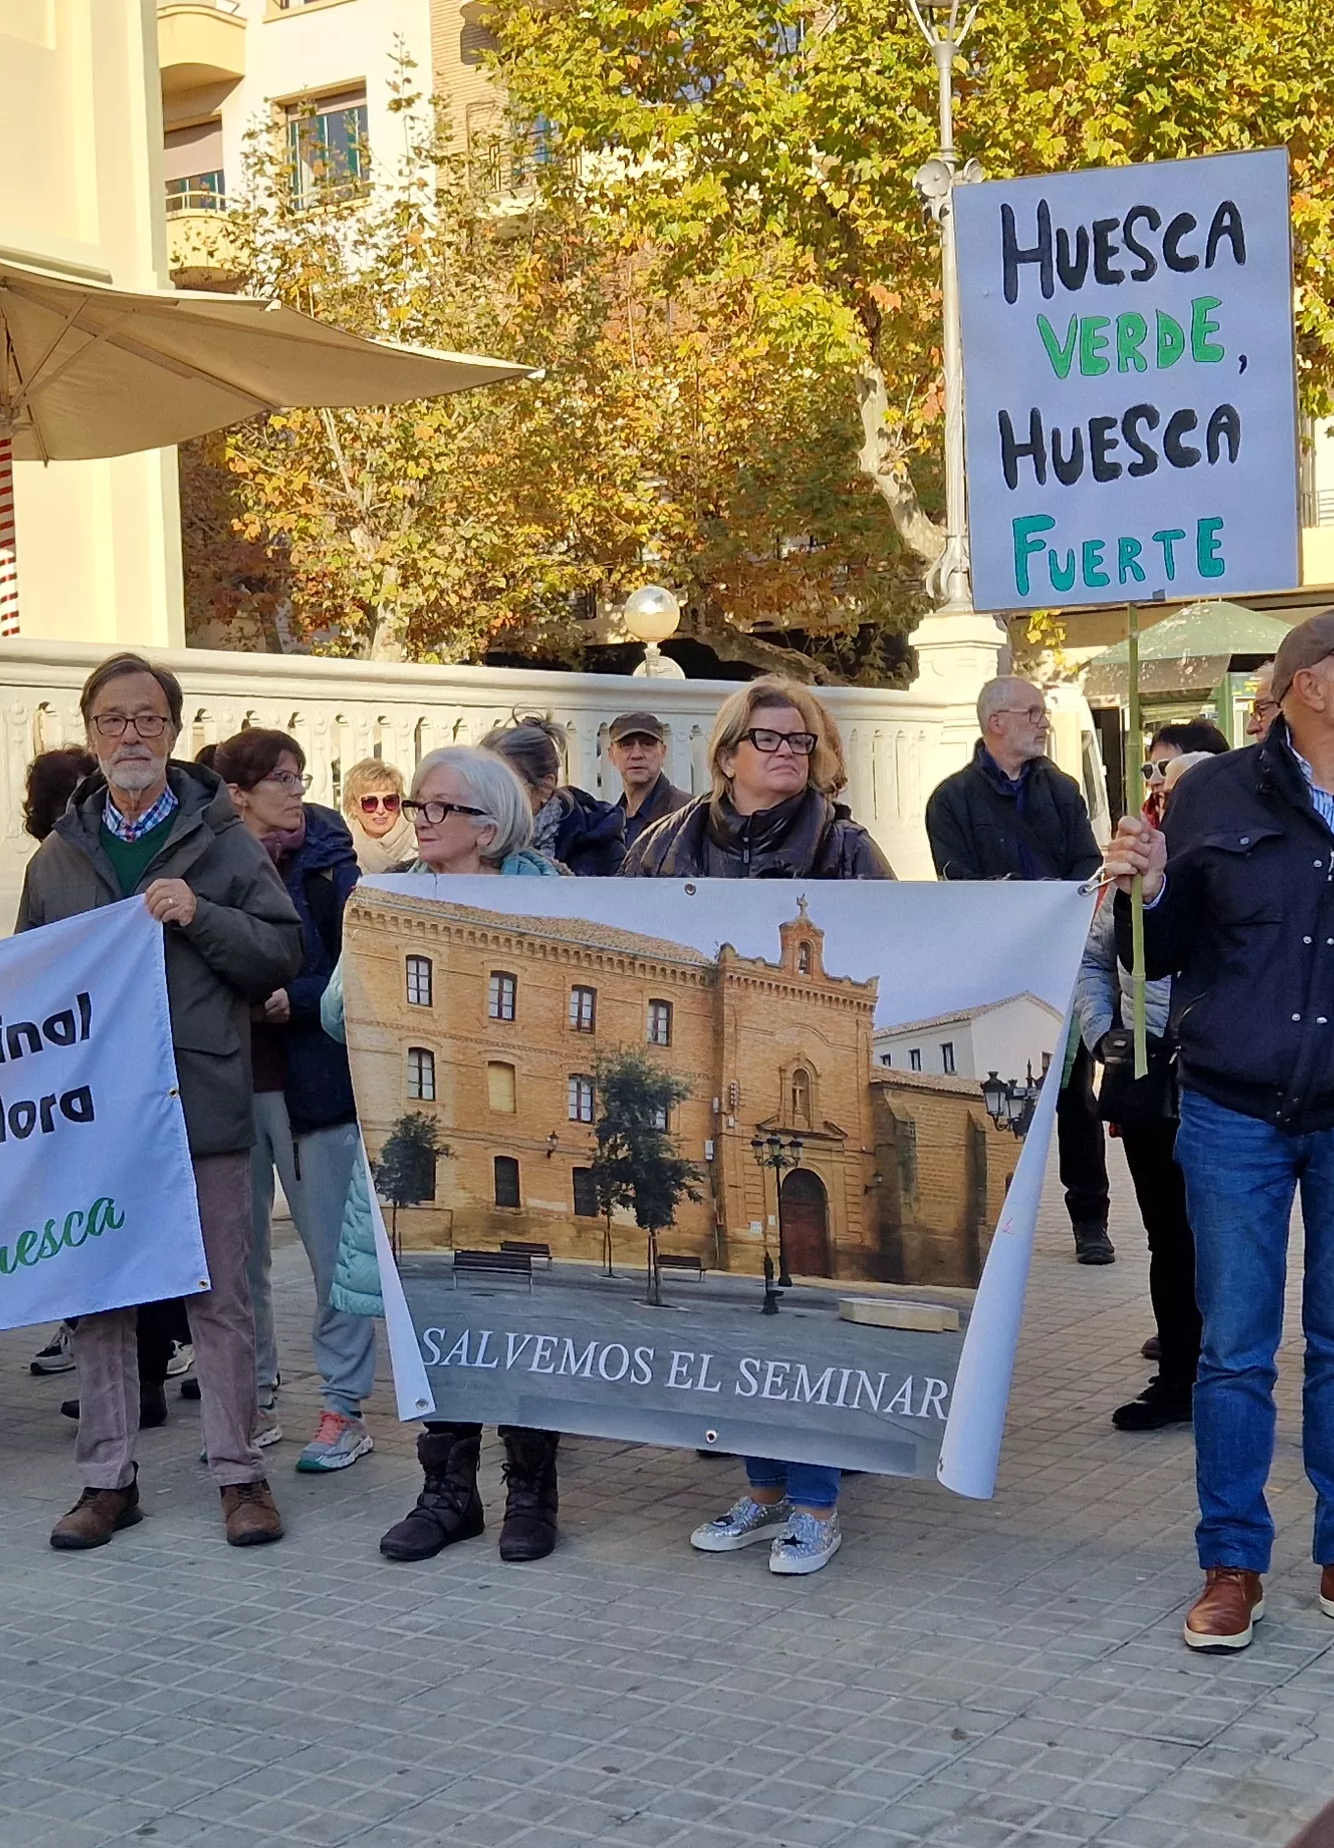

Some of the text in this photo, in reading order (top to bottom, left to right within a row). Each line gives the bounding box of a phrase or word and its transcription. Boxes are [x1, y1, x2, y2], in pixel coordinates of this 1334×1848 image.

[1000, 199, 1247, 304] HUESCA
[1036, 296, 1248, 380] VERDE,
[998, 403, 1242, 491] HUESCA
[1011, 515, 1227, 597] FUERTE
[422, 1327, 949, 1421] SALVEMOS EL SEMINAR
